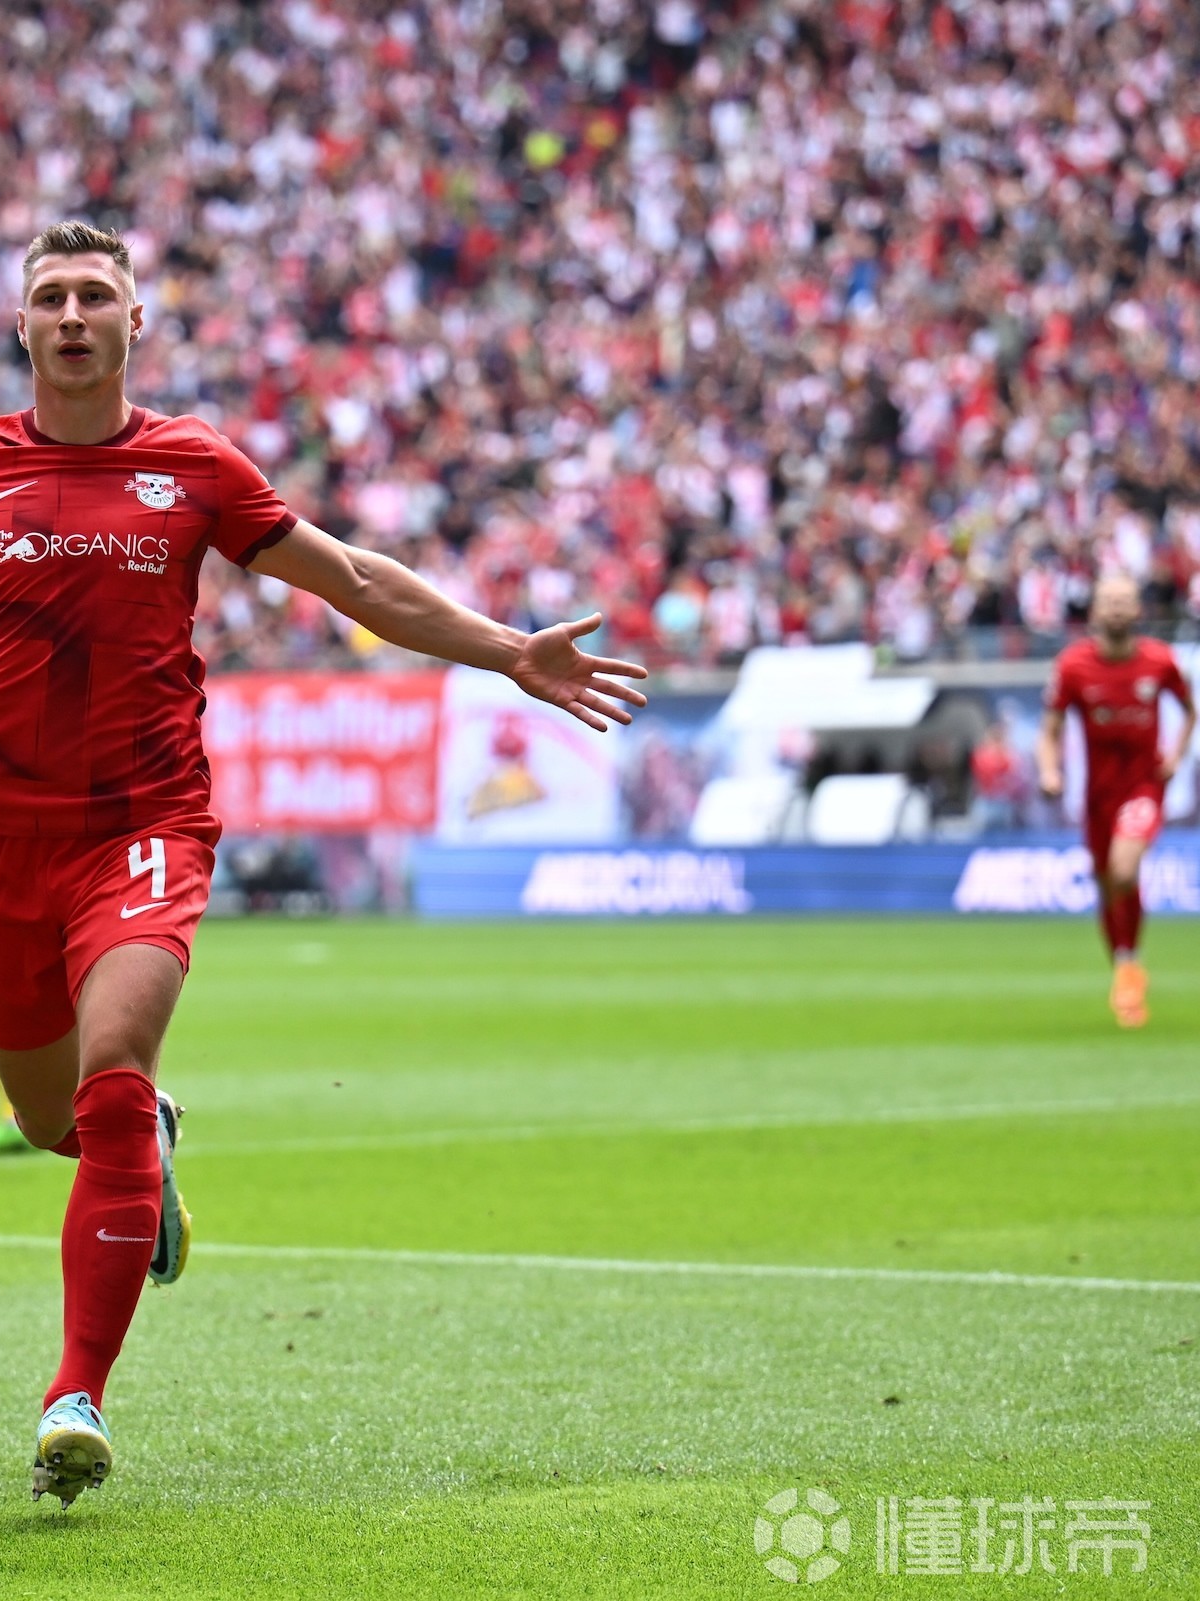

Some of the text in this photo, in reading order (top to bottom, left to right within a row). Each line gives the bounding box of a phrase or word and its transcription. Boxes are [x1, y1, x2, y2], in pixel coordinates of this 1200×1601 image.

[22, 531, 170, 563] ORGANICS
[128, 559, 147, 573] Red
[147, 563, 165, 575] Bull
[127, 837, 166, 899] 4
